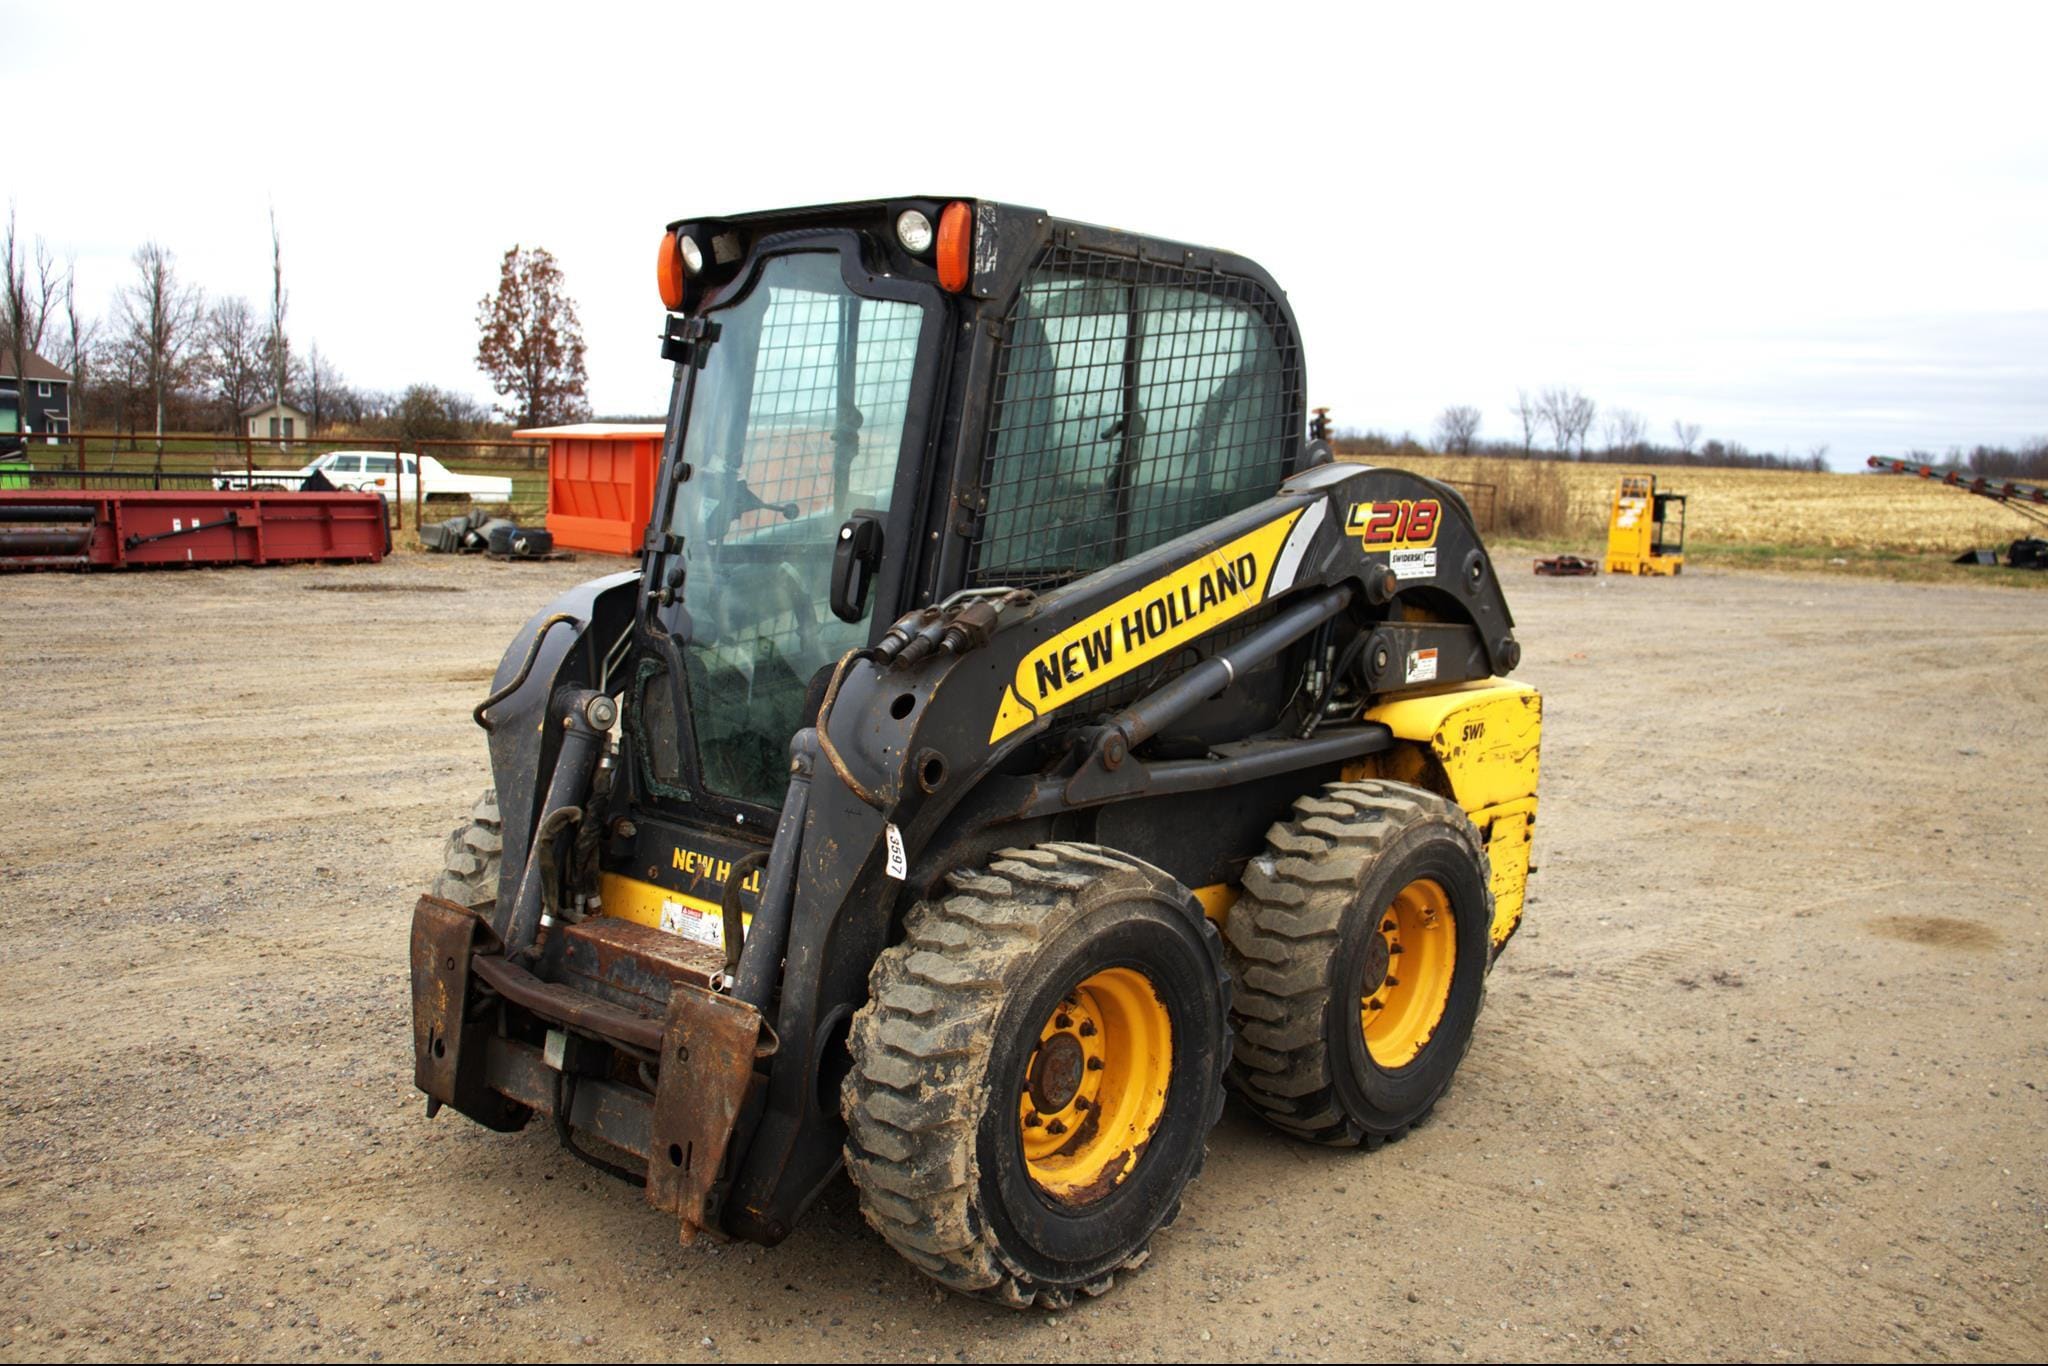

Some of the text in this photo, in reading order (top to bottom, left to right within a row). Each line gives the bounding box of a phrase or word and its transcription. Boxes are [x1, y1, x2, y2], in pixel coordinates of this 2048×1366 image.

[1035, 552, 1256, 699] NEW HOLLAND
[672, 847, 714, 878] NEW
[889, 835, 903, 874] 3597
